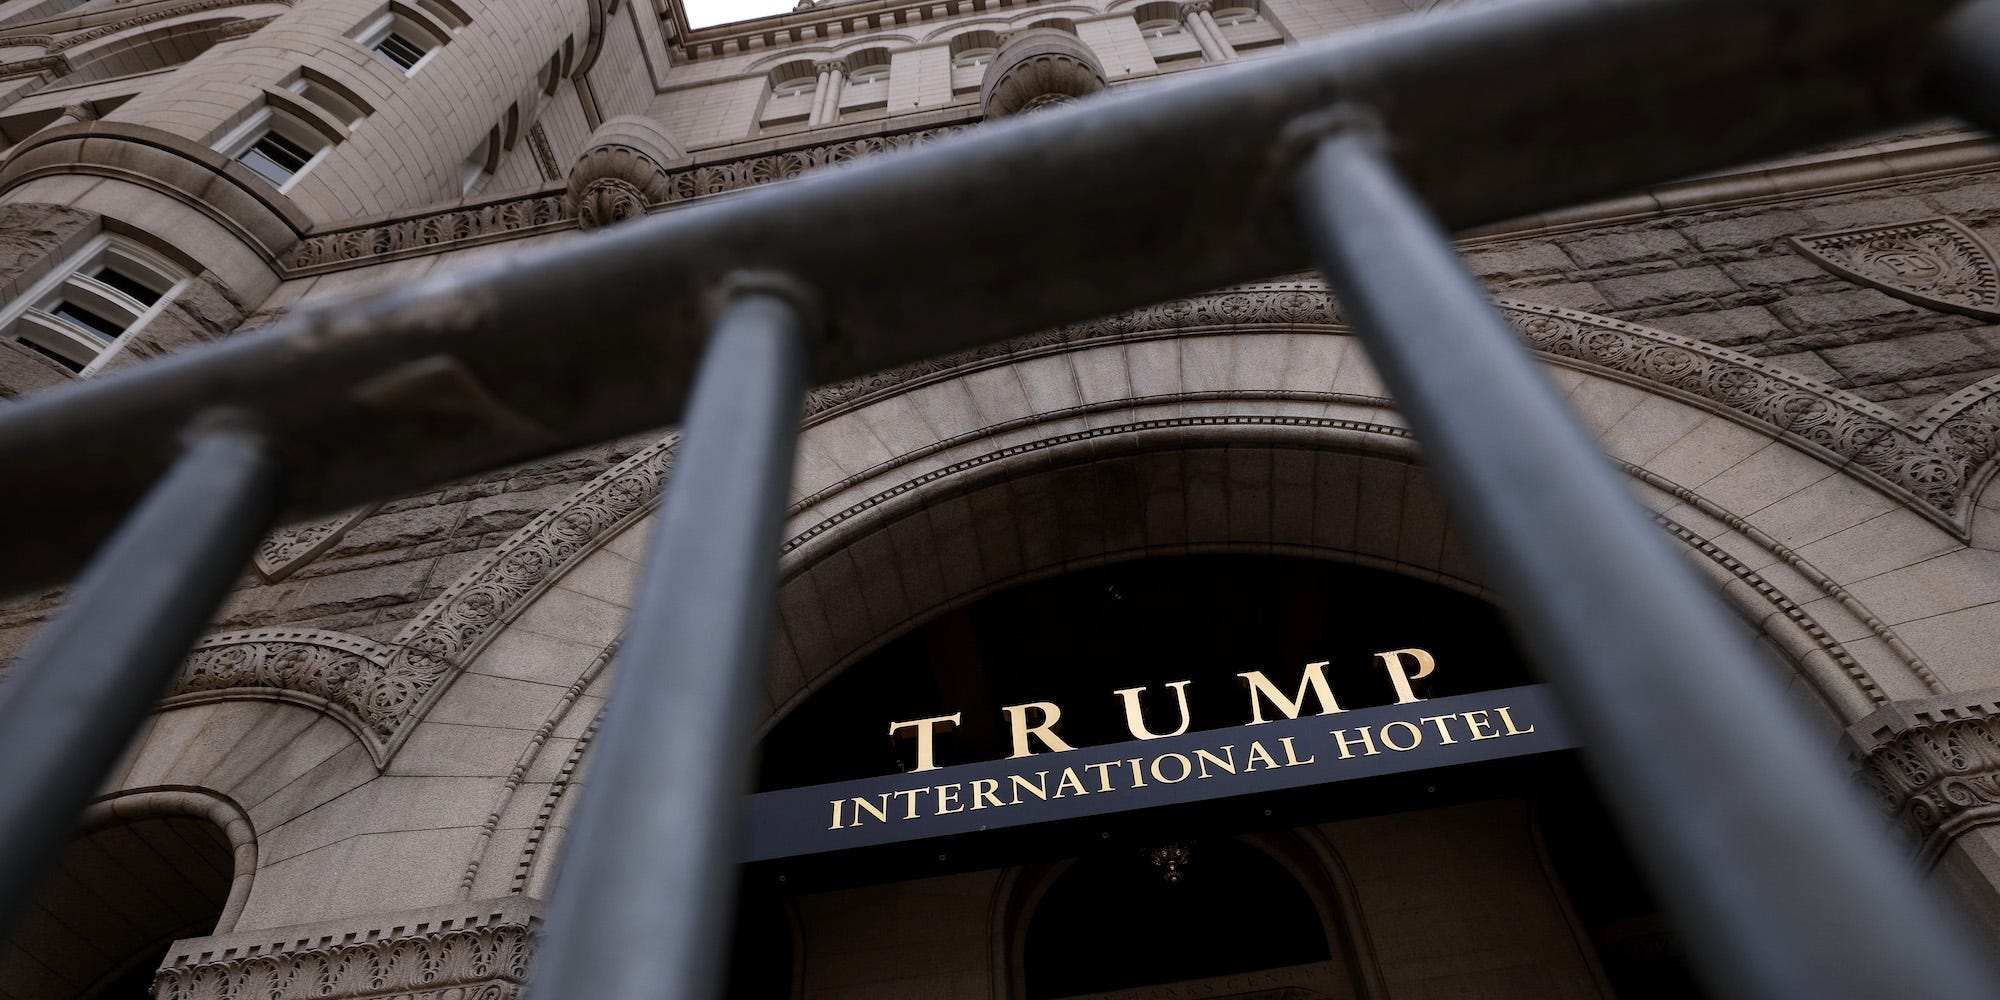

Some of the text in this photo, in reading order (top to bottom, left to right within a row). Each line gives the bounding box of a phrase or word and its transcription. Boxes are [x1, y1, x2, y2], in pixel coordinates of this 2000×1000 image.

[828, 706, 1535, 830] INTERNATIONAL HOTEL
[889, 648, 1438, 773] TRUMP
